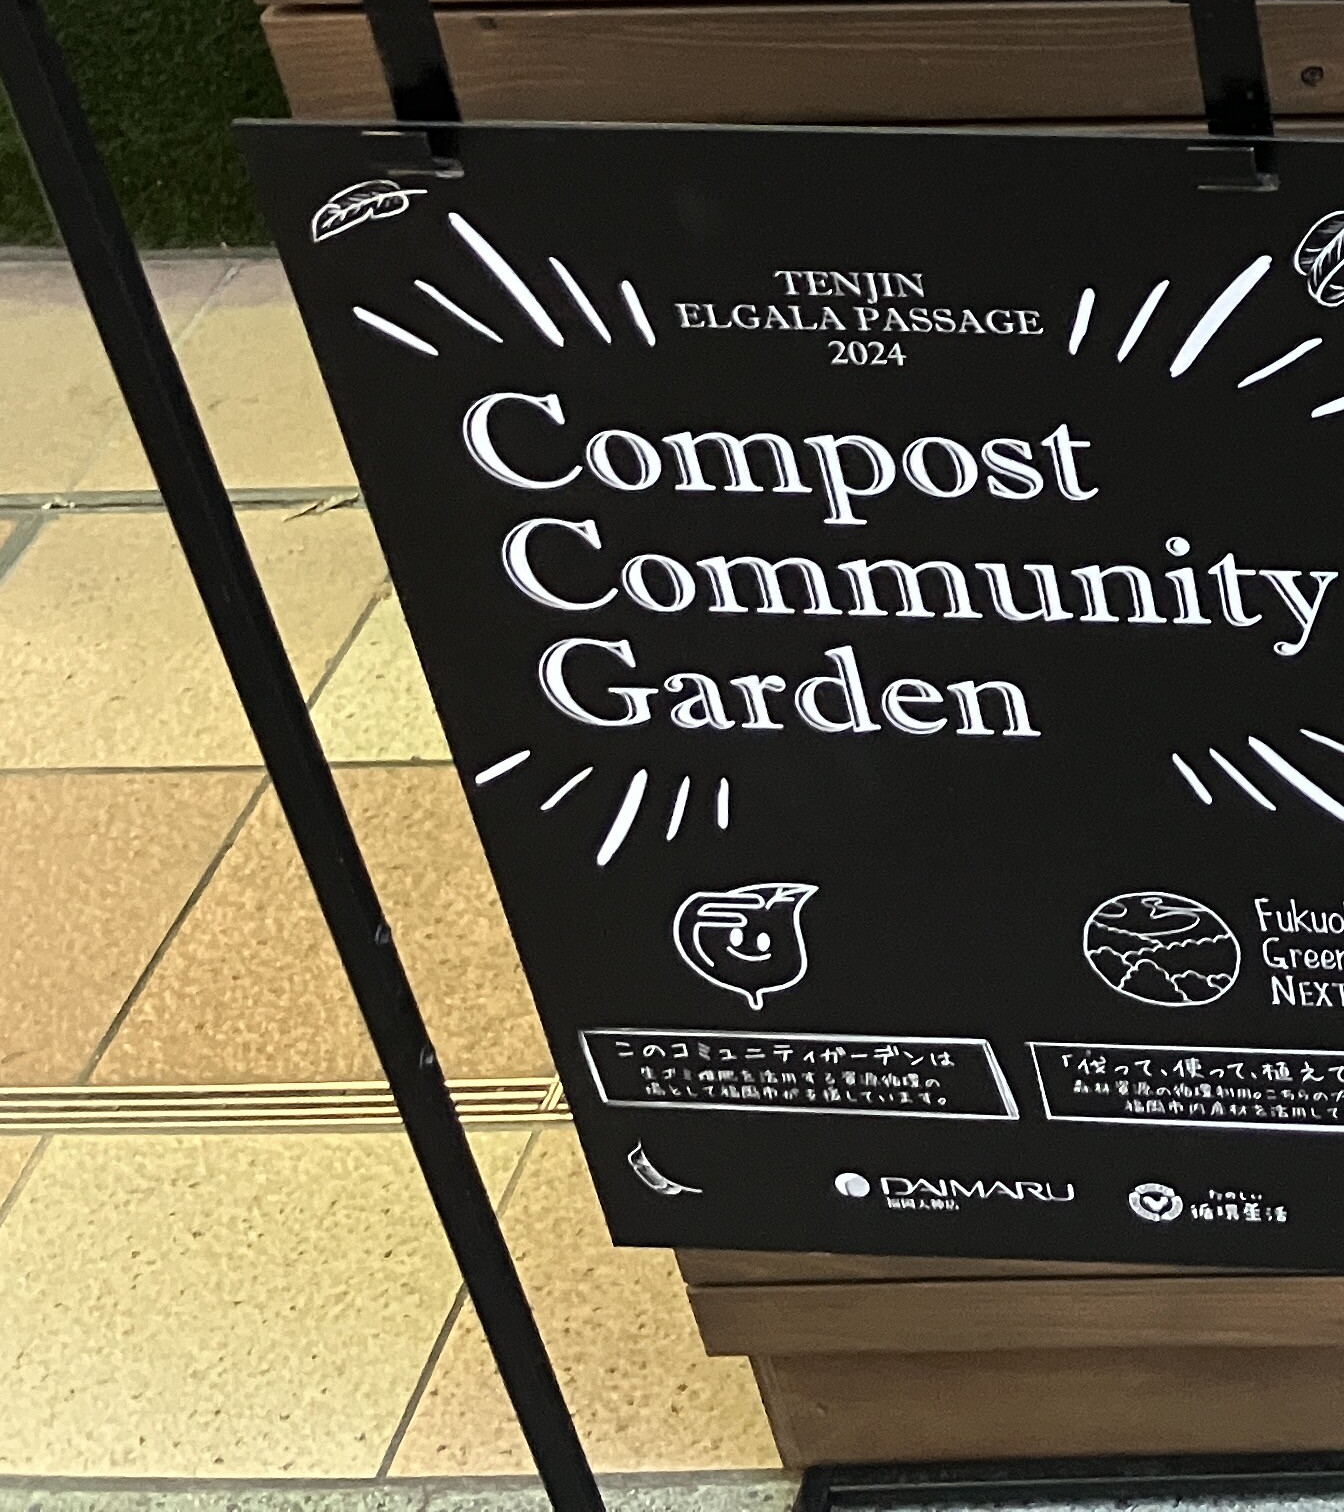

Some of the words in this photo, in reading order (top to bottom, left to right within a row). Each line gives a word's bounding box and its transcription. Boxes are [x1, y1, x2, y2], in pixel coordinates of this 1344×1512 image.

[774, 271, 924, 304] TENJIN
[675, 304, 846, 330] ELGALA
[854, 307, 1043, 334] PASSAGE
[828, 341, 906, 366] 2024
[463, 393, 1098, 525] Compost
[502, 517, 1338, 656] Community
[539, 638, 1041, 736] Garden
[615, 1042, 955, 1067] このコミュニティガーデンは
[881, 1177, 1074, 1201] DAIMARU
